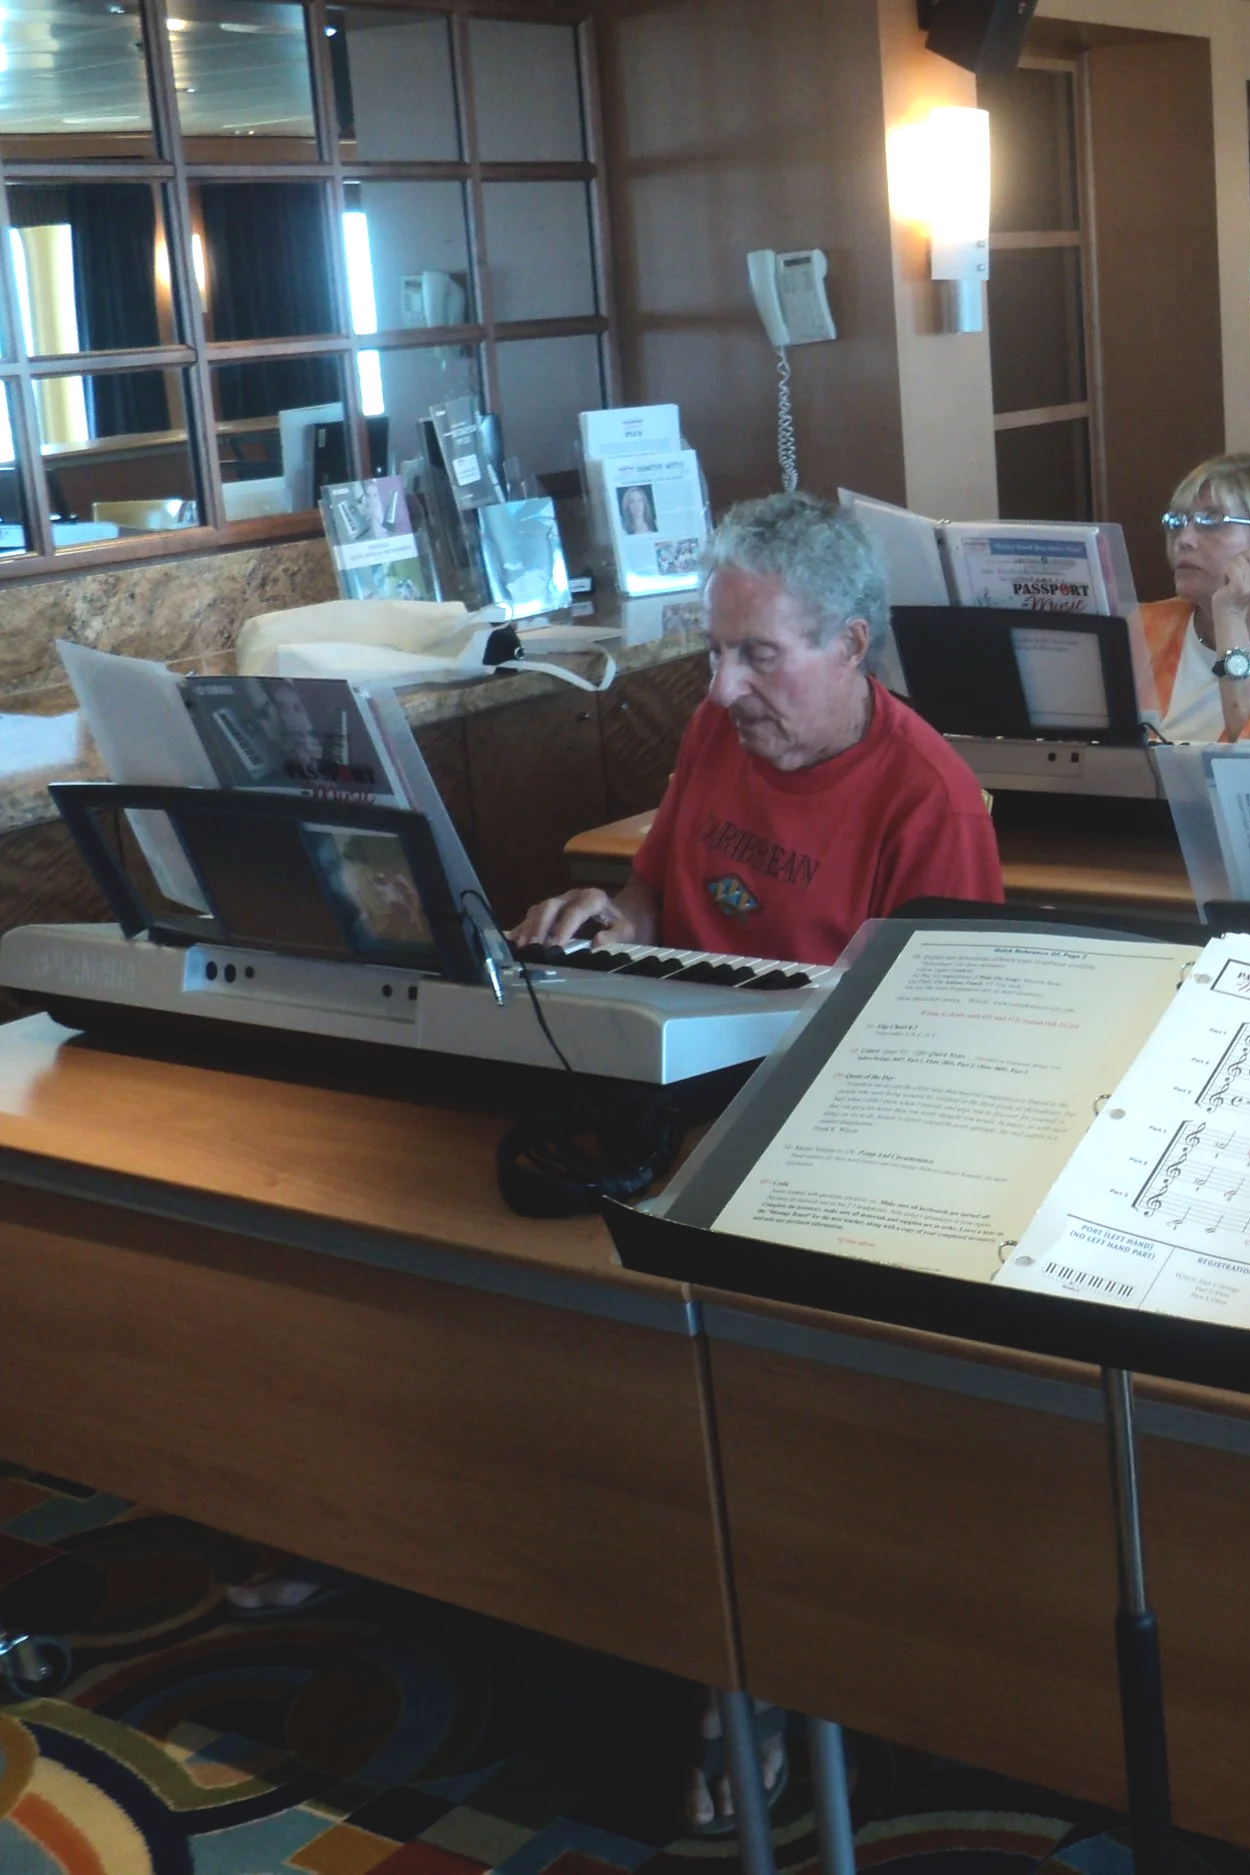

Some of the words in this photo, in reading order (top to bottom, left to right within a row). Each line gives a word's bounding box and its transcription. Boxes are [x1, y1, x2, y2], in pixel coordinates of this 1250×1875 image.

[1012, 583, 1090, 597] PASSPORT
[1209, 1027, 1221, 1035] Part
[1069, 1230, 1086, 1241] (NO
[1087, 1234, 1106, 1247] LEFT
[1107, 1241, 1131, 1254] HAND
[1132, 1248, 1156, 1261] PART)
[1082, 1224, 1103, 1236] PORT
[1104, 1230, 1126, 1244] (LEFT
[1127, 1237, 1155, 1251] HAND)
